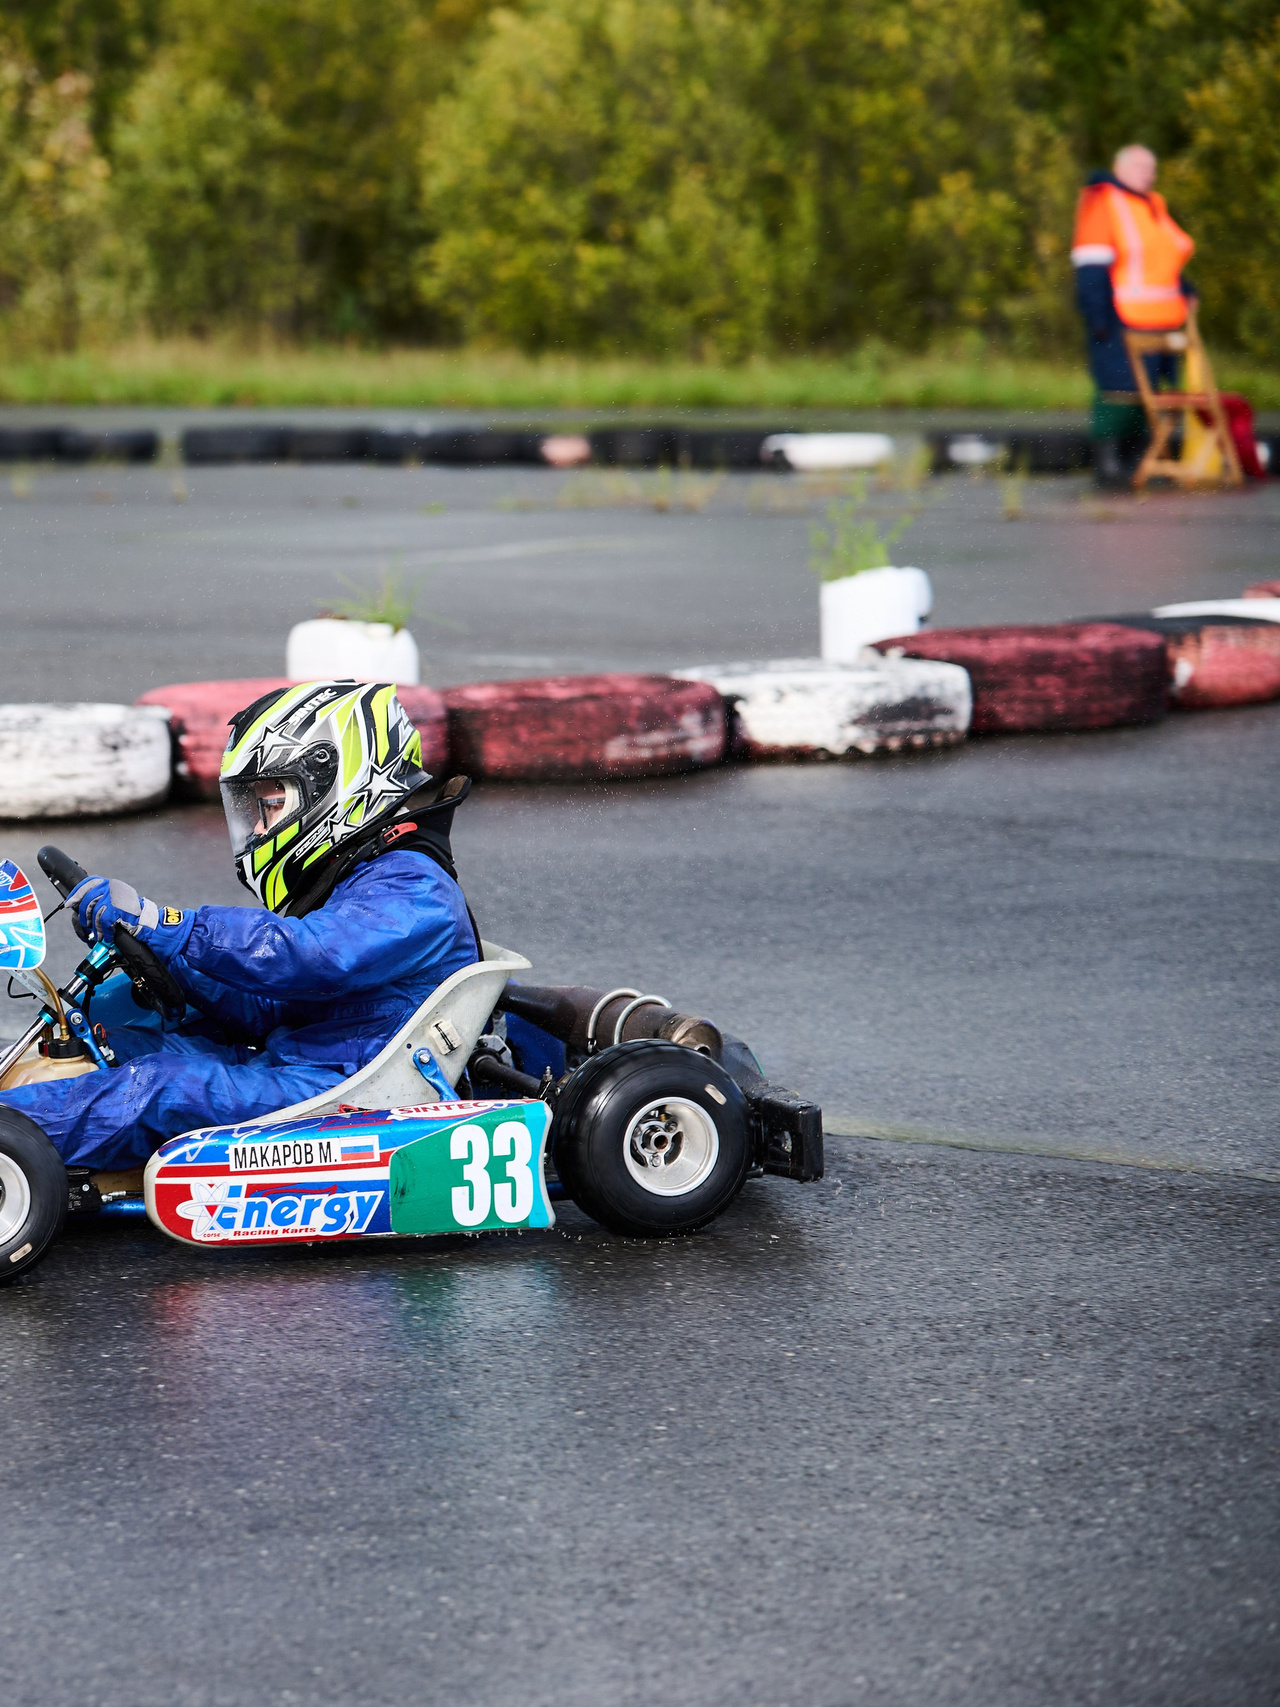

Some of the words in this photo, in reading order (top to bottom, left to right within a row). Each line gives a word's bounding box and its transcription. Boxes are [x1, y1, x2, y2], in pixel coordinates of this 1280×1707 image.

[288, 688, 337, 726] SINTEC
[398, 1101, 489, 1114] SINTEC
[233, 1143, 314, 1169] МАКАРОВ
[318, 1141, 338, 1163] М.
[450, 1121, 534, 1226] 33
[209, 1185, 377, 1232] Energy
[233, 1229, 279, 1237] Racing
